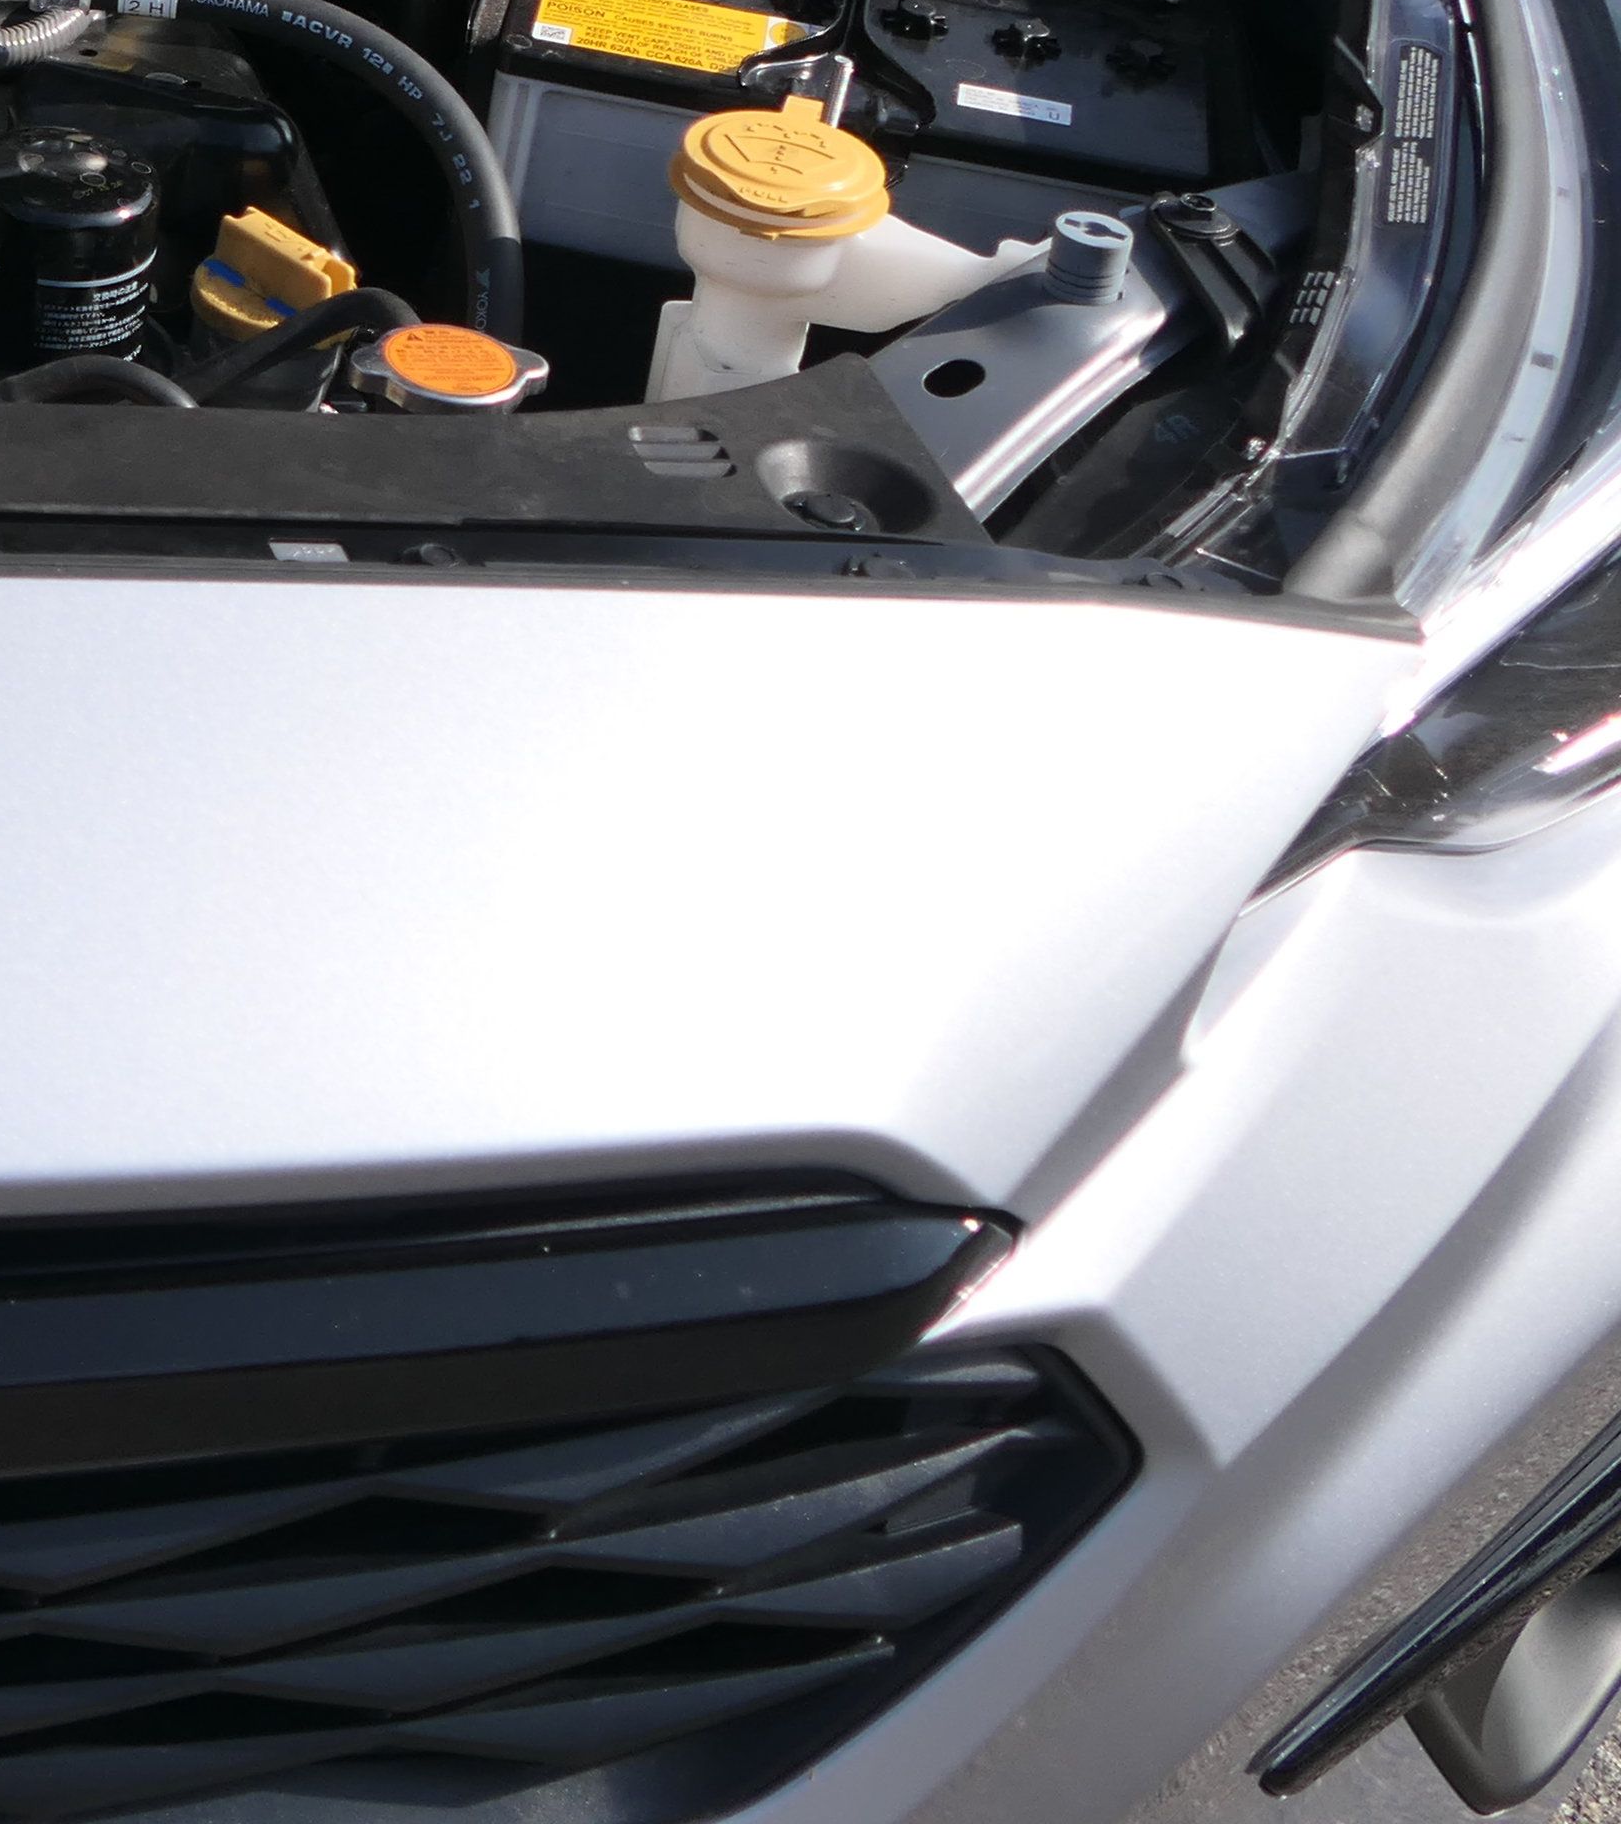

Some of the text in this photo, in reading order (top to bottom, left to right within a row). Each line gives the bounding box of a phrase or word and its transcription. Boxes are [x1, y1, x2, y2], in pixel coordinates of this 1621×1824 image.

[546, 1, 606, 18] POISON
[614, 14, 655, 28] CAUSES
[577, 37, 608, 49] 20HR
[646, 50, 672, 62] CCA
